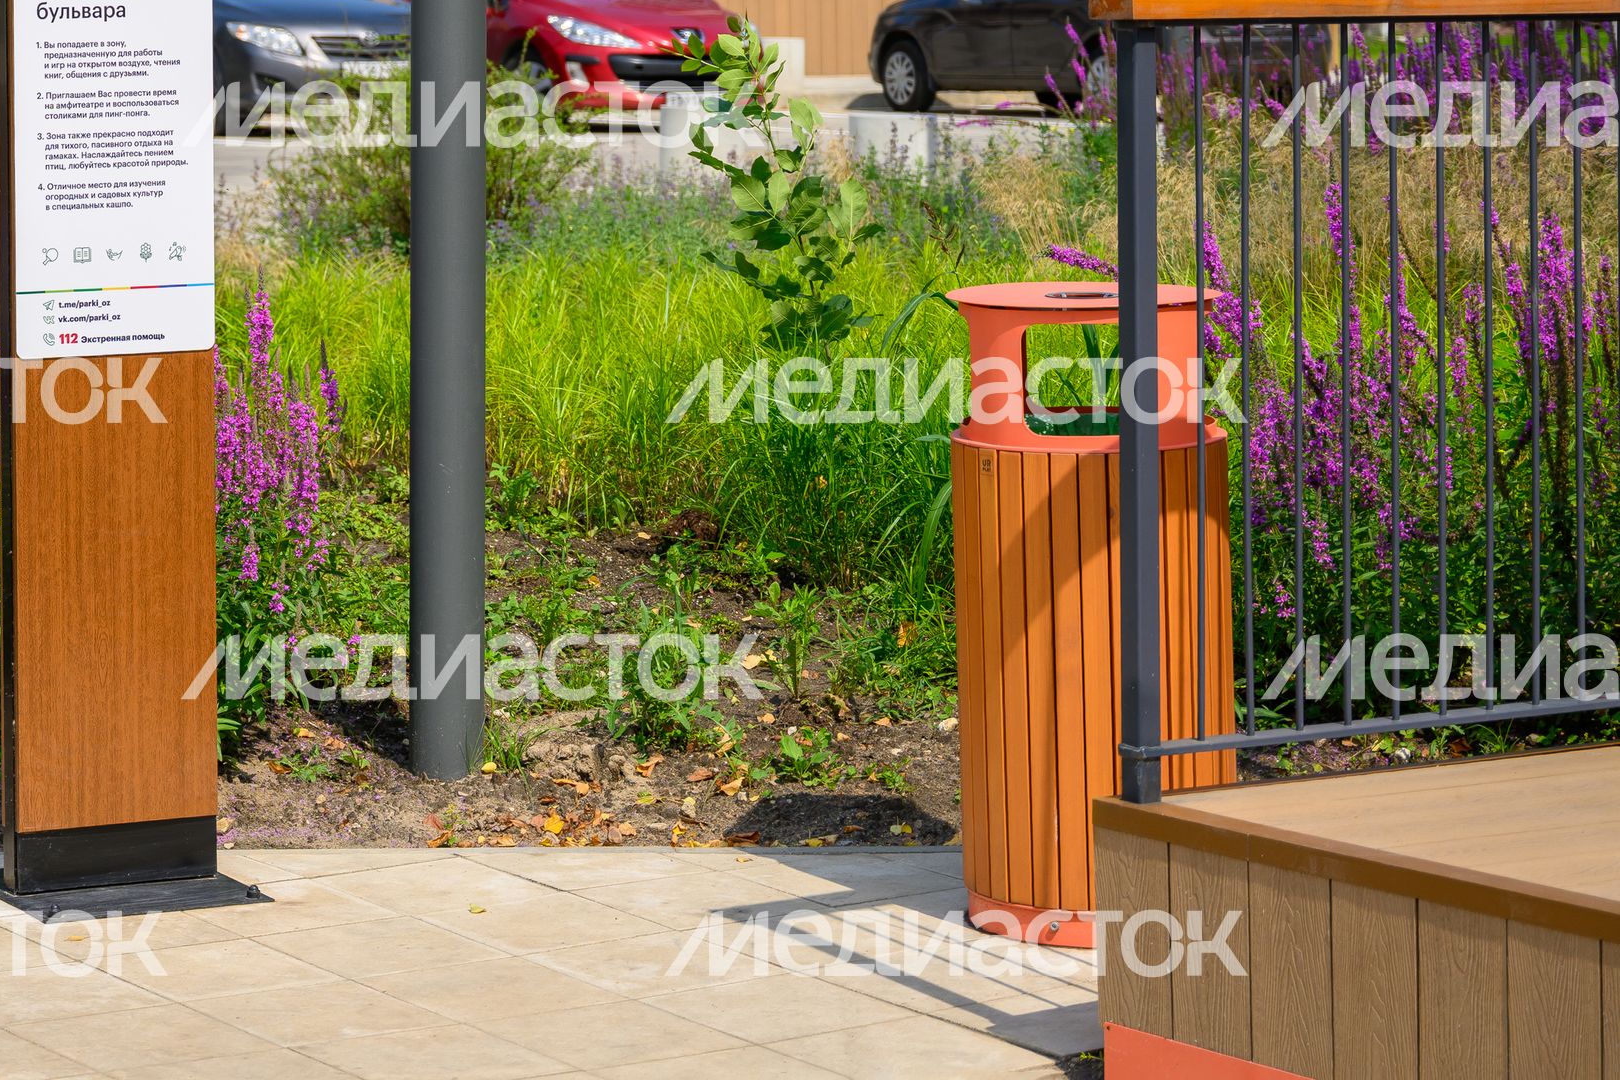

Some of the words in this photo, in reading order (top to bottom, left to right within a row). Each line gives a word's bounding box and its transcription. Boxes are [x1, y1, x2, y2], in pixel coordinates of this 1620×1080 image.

[36, 1, 126, 23] бульвара
[36, 41, 42, 49] 1.
[44, 41, 55, 49] Вы
[56, 41, 99, 49] попадаете
[44, 51, 117, 60] предназначенную
[117, 50, 132, 58] для
[133, 48, 163, 58] работы
[78, 61, 117, 69] открытом
[118, 60, 152, 68] воздухе,
[65, 70, 101, 79] общения
[109, 70, 149, 78] друзьями.
[36, 92, 44, 100] 2.
[46, 91, 96, 102] Приглашаем
[98, 90, 112, 98] Вас
[114, 90, 151, 98] провести
[152, 89, 177, 97] время
[56, 101, 104, 110] амфитеатре
[112, 99, 179, 107] воспользоваться
[36, 132, 44, 140] 3.
[46, 132, 66, 140] Зона
[92, 131, 136, 139] прекрасно
[44, 143, 59, 151] для
[60, 142, 89, 150] тихого,
[134, 140, 162, 148] отдыха
[81, 149, 143, 159] Наслаждайтесь
[68, 161, 111, 170] любуйтесь
[112, 159, 150, 168] красотой
[151, 159, 188, 168] природы.
[113, 181, 128, 189] для
[129, 180, 166, 188] изучения
[45, 193, 89, 201] огородных
[97, 191, 131, 199] садовых
[132, 190, 163, 198] культур
[52, 202, 104, 211] специальных
[58, 299, 111, 309] t.me/parki_oz
[58, 313, 121, 324] vk.com/parki_oz
[59, 332, 78, 344] 112
[81, 334, 130, 344] Экстренная
[132, 333, 166, 342] помощь
